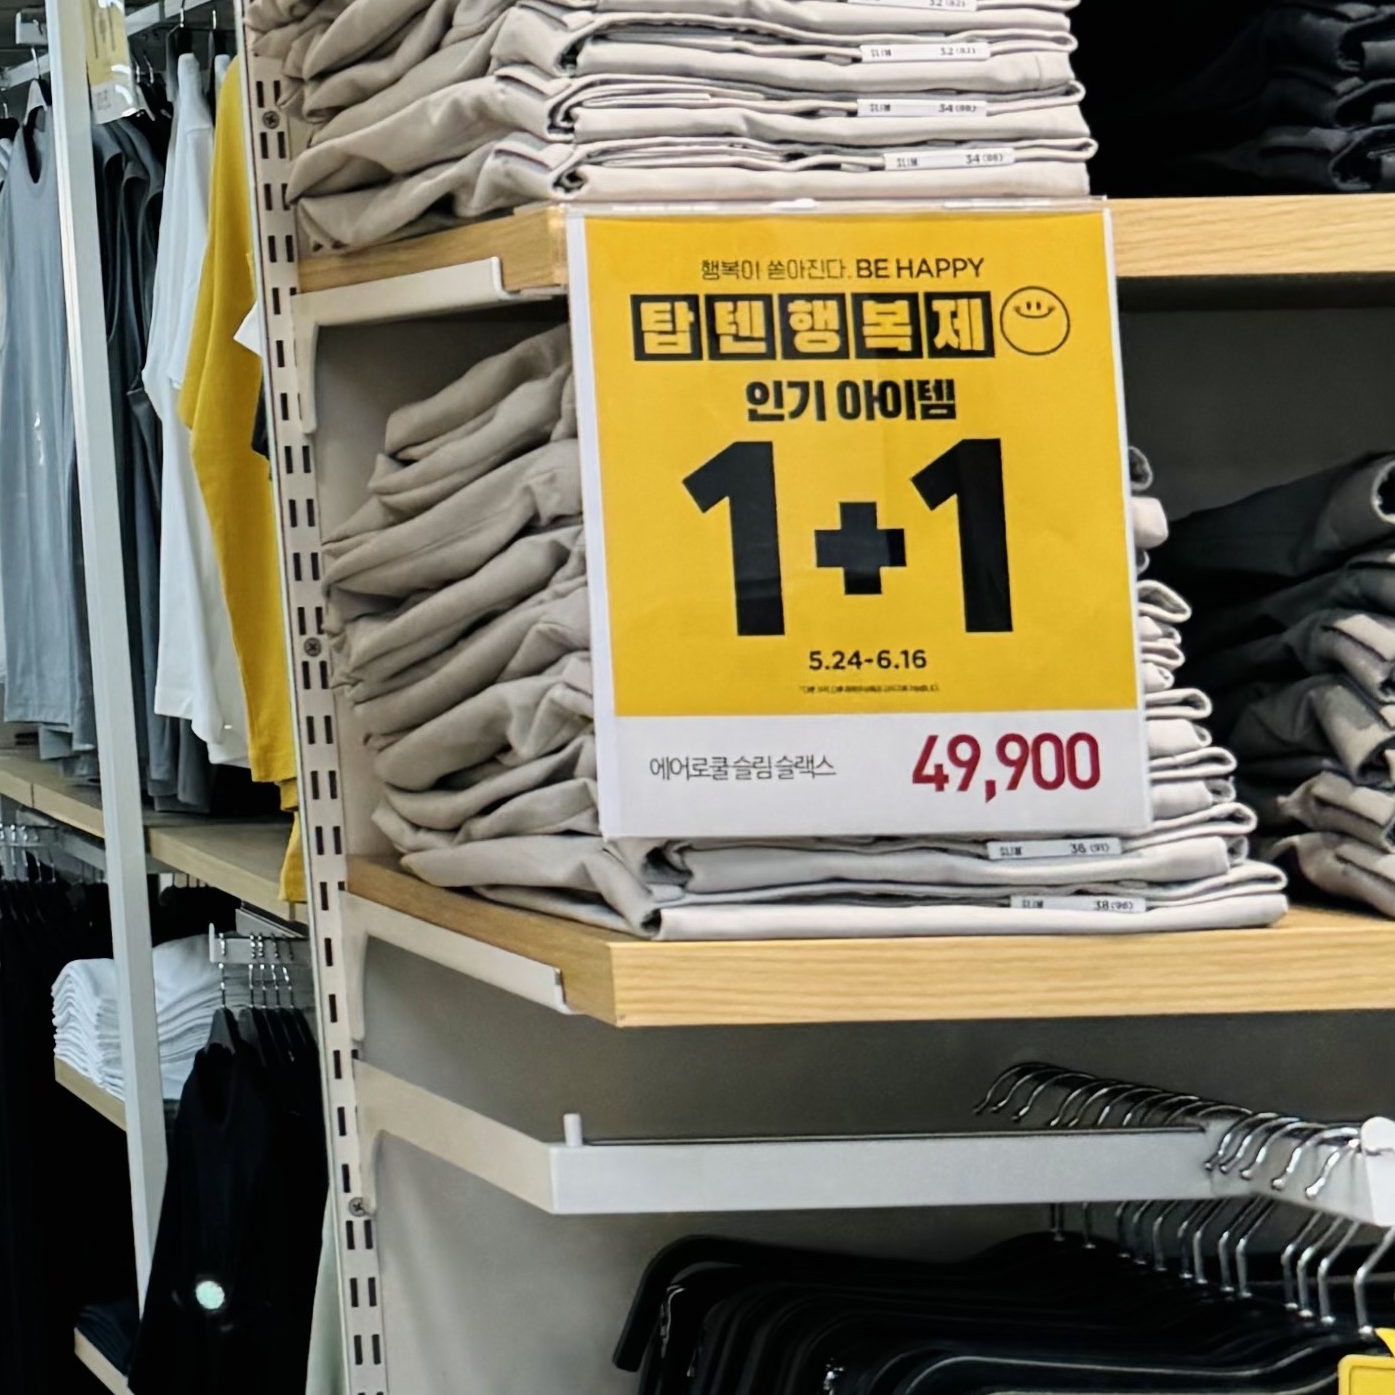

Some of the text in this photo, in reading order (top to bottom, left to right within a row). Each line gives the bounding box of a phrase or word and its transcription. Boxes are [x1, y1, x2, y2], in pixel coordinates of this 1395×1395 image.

[701, 259, 761, 281] 행복이
[856, 257, 890, 279] BE
[896, 257, 985, 279] HAPPY
[746, 377, 957, 422] 인기 아이템
[682, 438, 1013, 636] 1+1
[809, 649, 928, 671] 5.24-6.16
[733, 754, 773, 781] 슬림
[775, 754, 838, 781] 슬랙스
[912, 732, 1101, 804] 49,900
